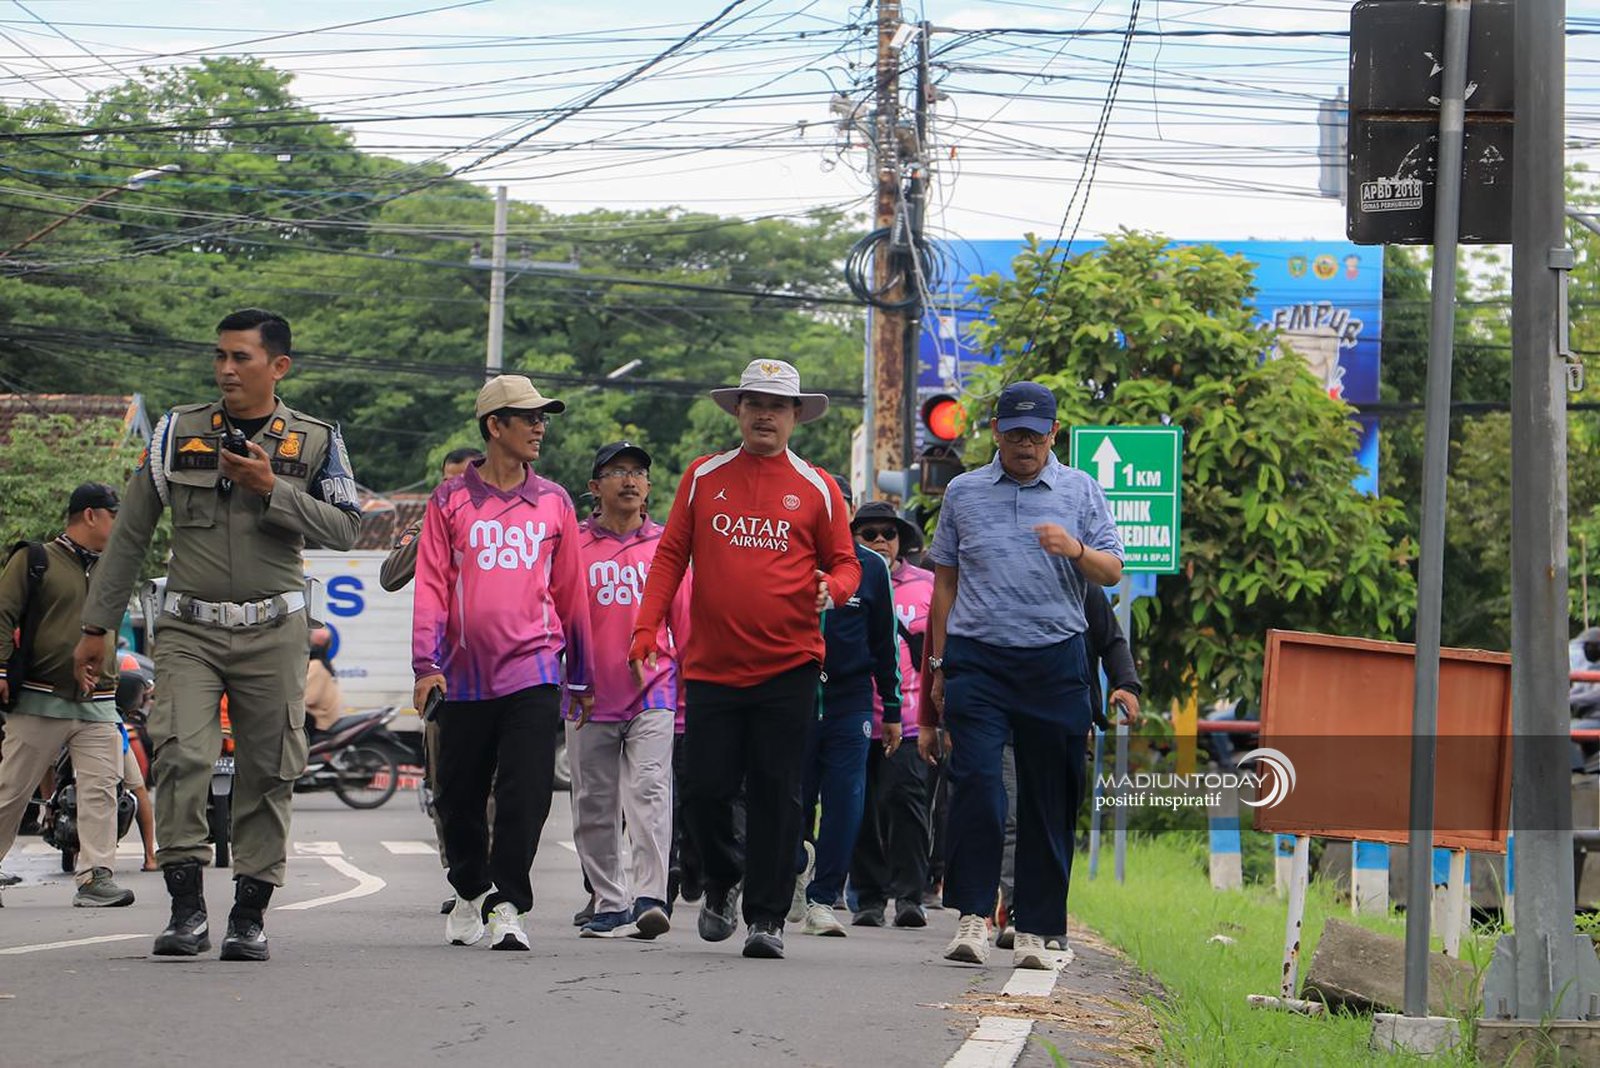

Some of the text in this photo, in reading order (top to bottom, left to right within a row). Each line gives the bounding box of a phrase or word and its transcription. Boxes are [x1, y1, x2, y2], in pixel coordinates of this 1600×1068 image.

[1363, 182, 1421, 200] APBD 2018
[1256, 300, 1363, 348] EMPUR
[1122, 463, 1162, 487] 1 KM
[1107, 500, 1152, 523] LINIK
[712, 513, 791, 539] QATAR
[729, 534, 789, 552] AIRWAYS
